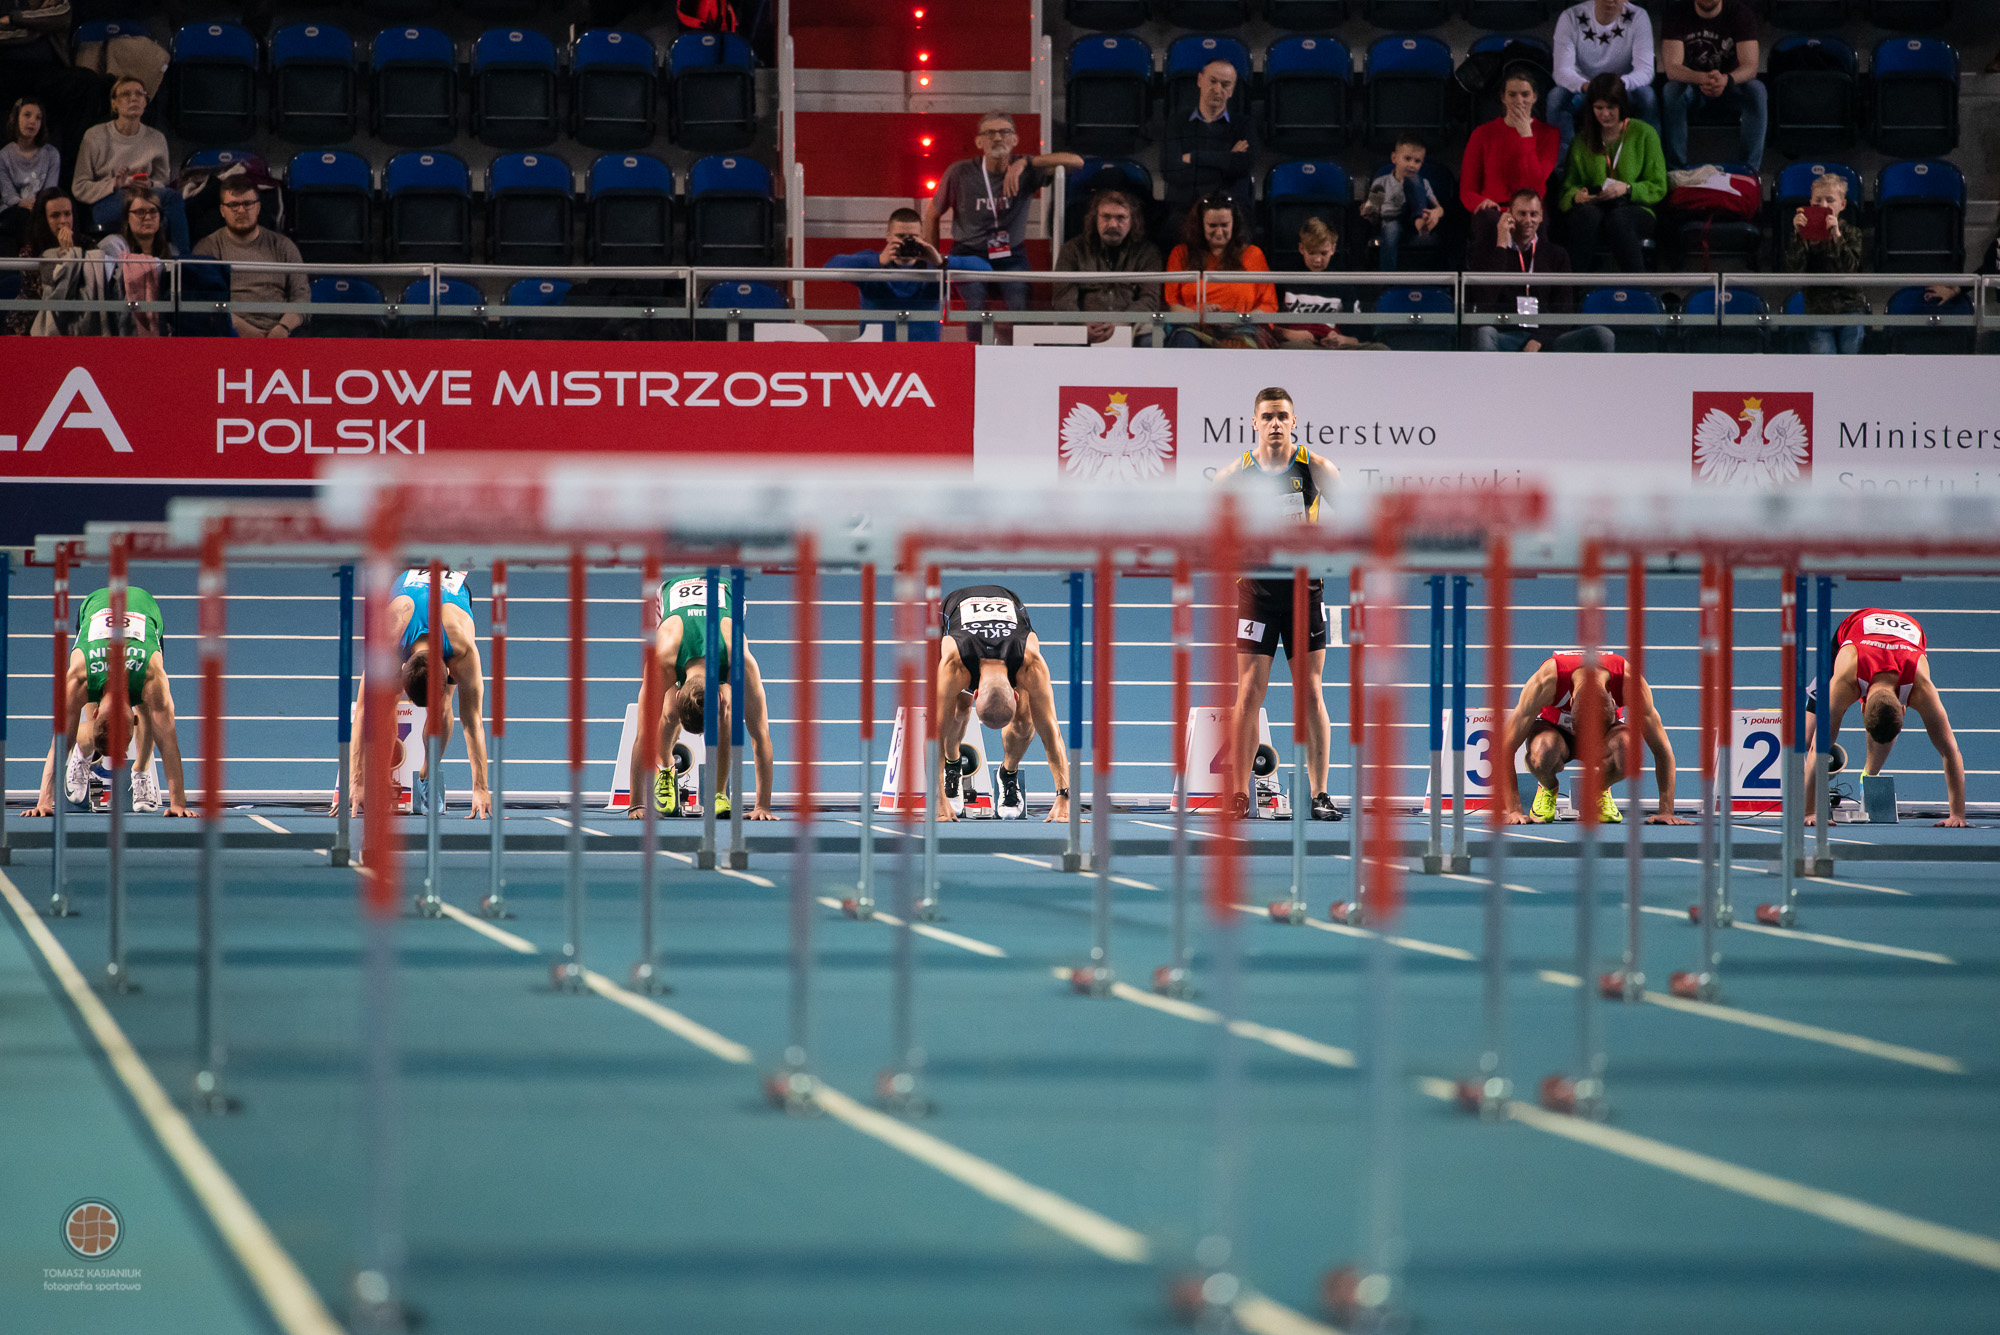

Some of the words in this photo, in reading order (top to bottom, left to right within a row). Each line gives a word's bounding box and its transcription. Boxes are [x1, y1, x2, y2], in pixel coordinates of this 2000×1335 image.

[217, 367, 473, 406] HALOWE
[492, 369, 937, 408] MISTRZOSTWA
[216, 417, 426, 455] POLSKI
[969, 603, 1008, 614] 291
[967, 628, 1012, 639] SKLA
[1243, 621, 1255, 637] 4
[1874, 617, 1912, 631] 205
[1465, 729, 1499, 788] 3
[1741, 730, 1782, 789] 2
